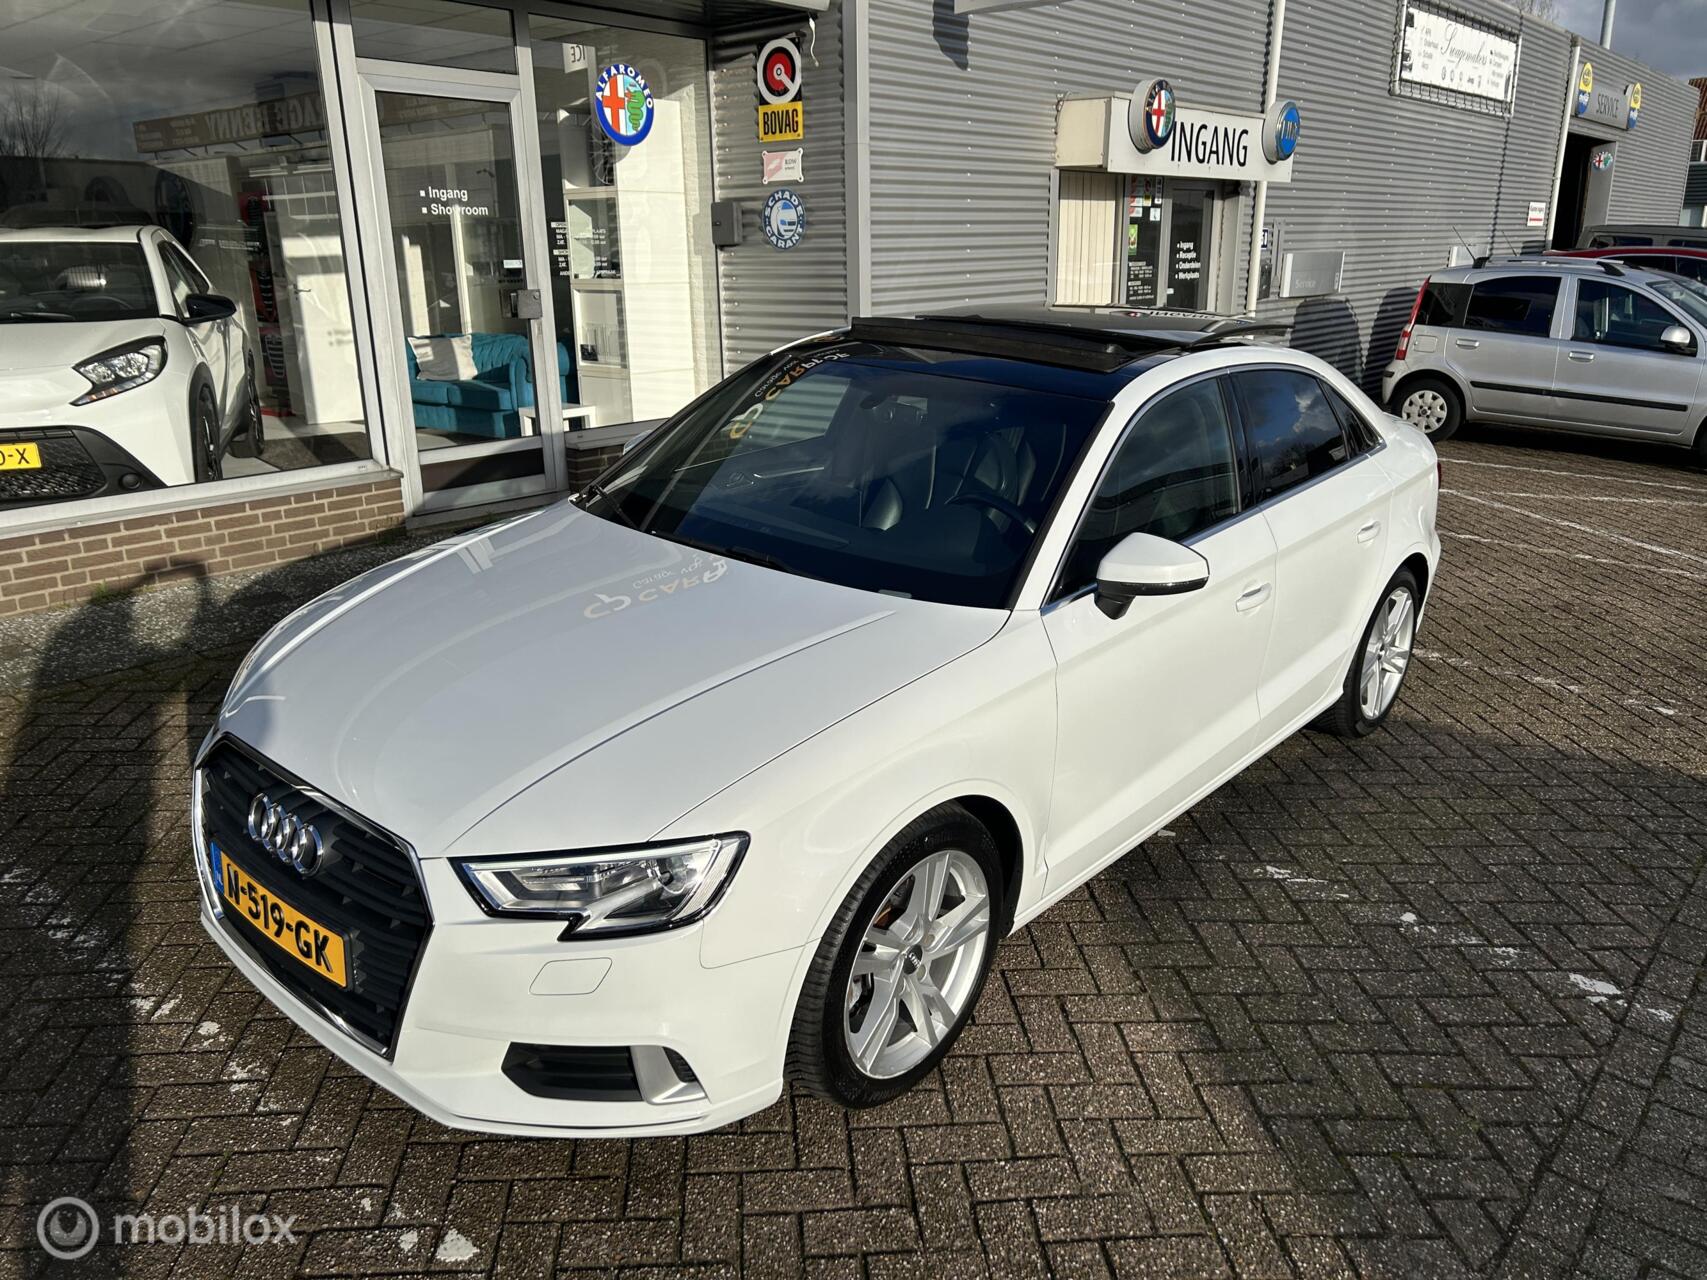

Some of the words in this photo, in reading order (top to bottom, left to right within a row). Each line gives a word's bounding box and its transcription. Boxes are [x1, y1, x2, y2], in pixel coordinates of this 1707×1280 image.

[1596, 93, 1620, 118] SERVICE
[763, 109, 799, 135] BOVAG
[1170, 121, 1249, 167] INGANG
[428, 186, 468, 202] Ingang
[764, 191, 804, 218] SCHADE
[766, 224, 804, 249] GARANT
[228, 863, 332, 972] N-519-GK
